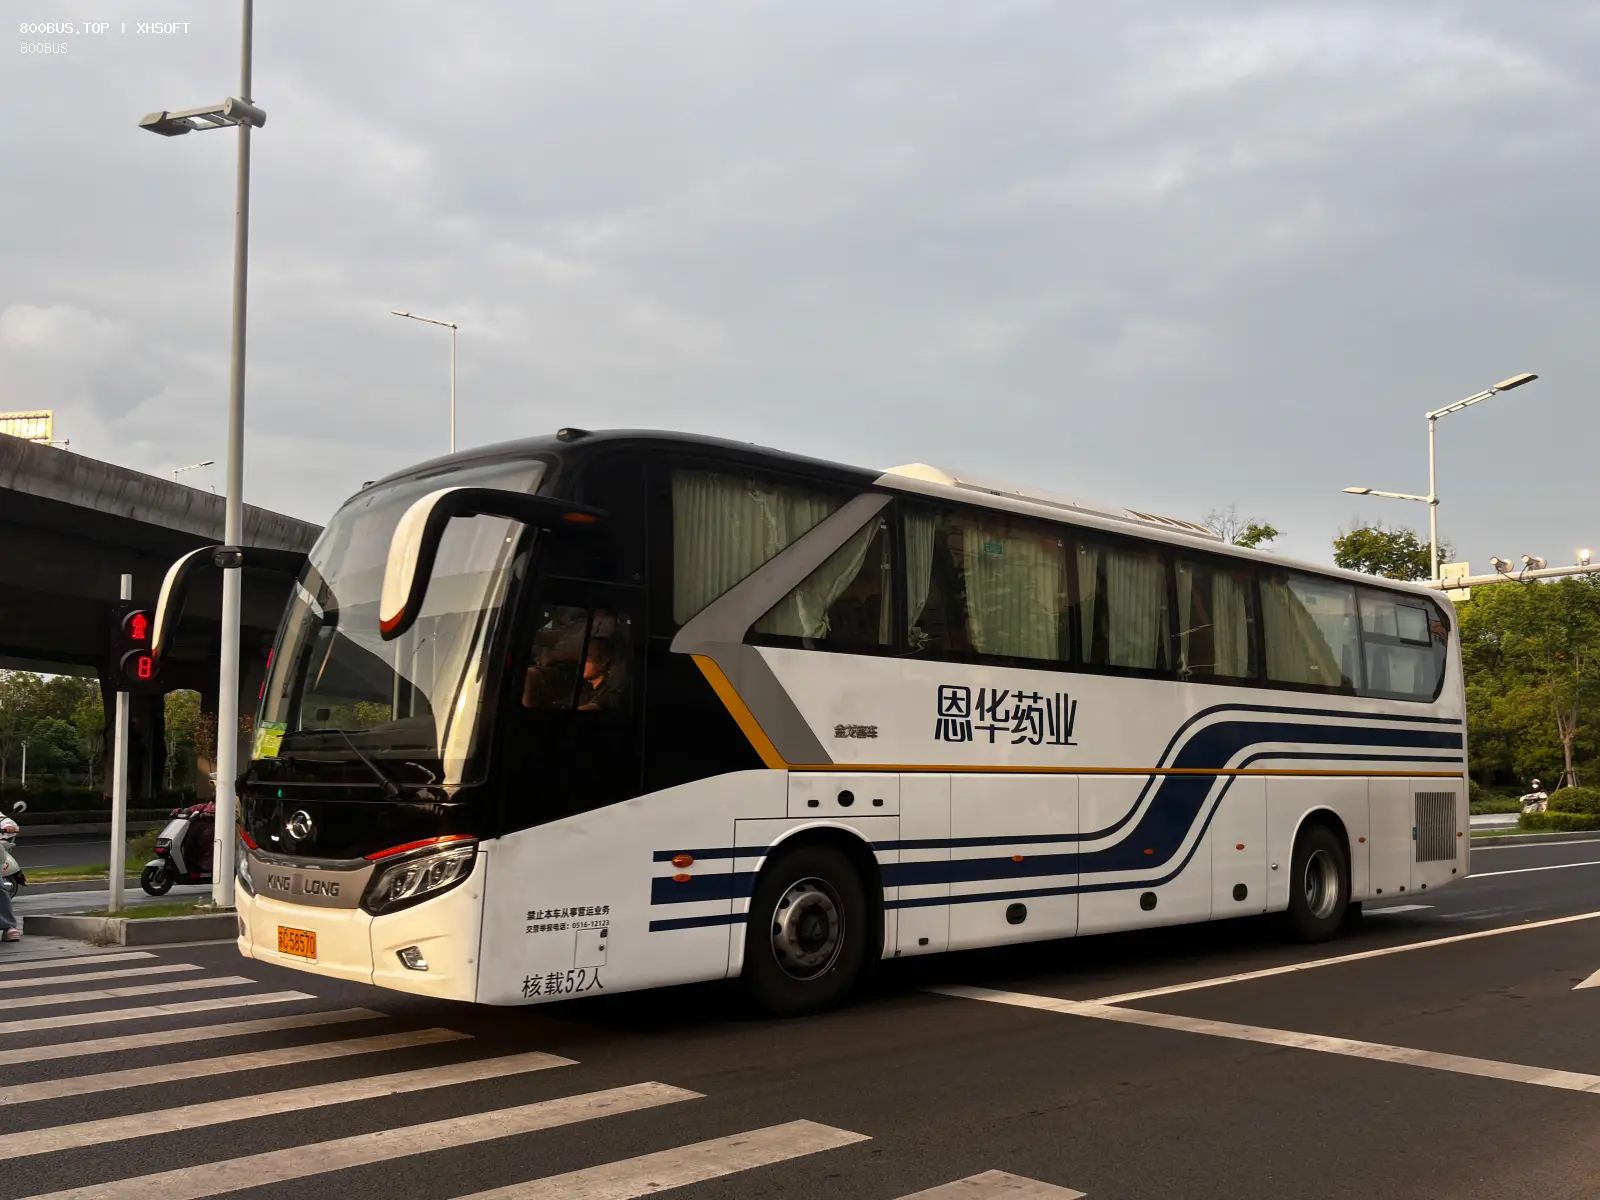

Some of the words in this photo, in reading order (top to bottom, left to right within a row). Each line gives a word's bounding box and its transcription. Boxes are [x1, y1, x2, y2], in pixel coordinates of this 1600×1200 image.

[934, 684, 1078, 746] 恩华药业
[833, 723, 879, 739] 金龙客车
[267, 874, 291, 891] KING
[302, 878, 340, 897] LONG
[526, 905, 610, 921] 禁止本车从事营运业务
[521, 967, 604, 999] 核载52人
